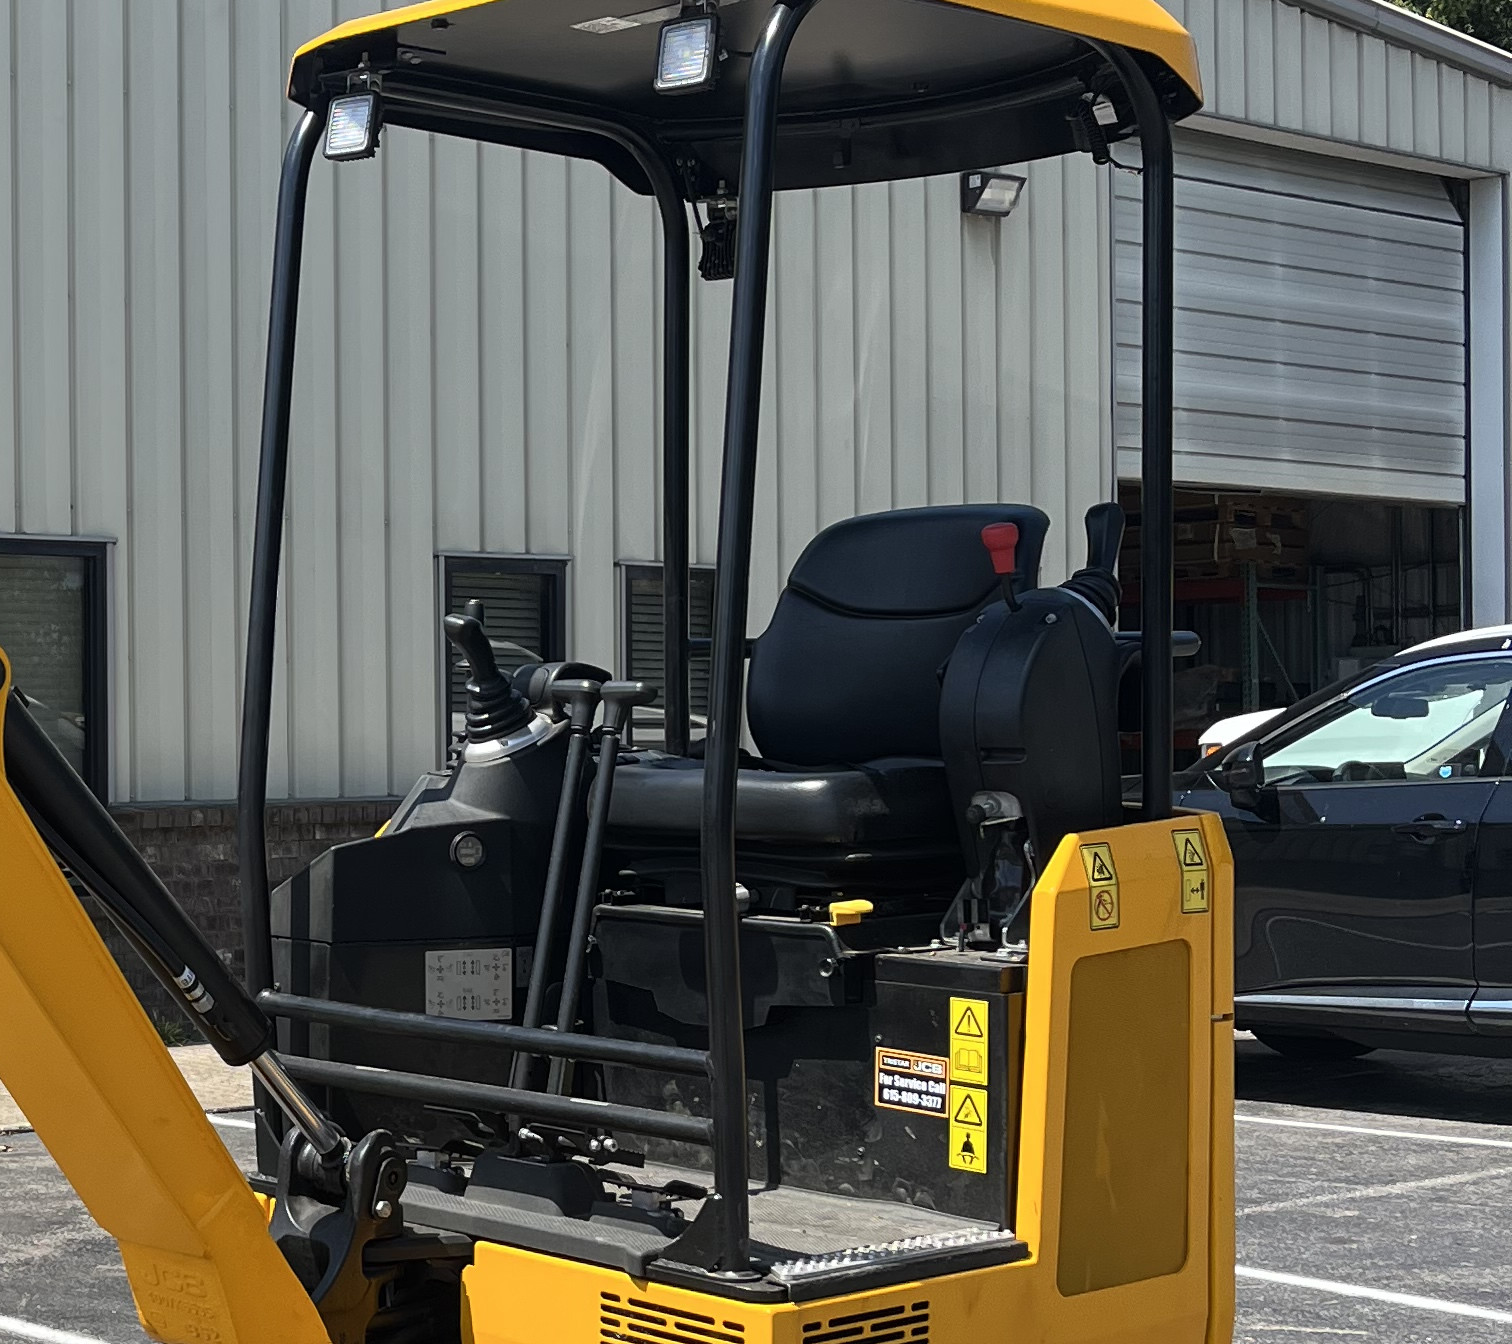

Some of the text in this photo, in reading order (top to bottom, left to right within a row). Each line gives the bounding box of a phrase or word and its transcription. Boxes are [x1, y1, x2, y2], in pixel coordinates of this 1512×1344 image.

[913, 1061, 943, 1074] JCB
[879, 1072, 947, 1095] For Service Call
